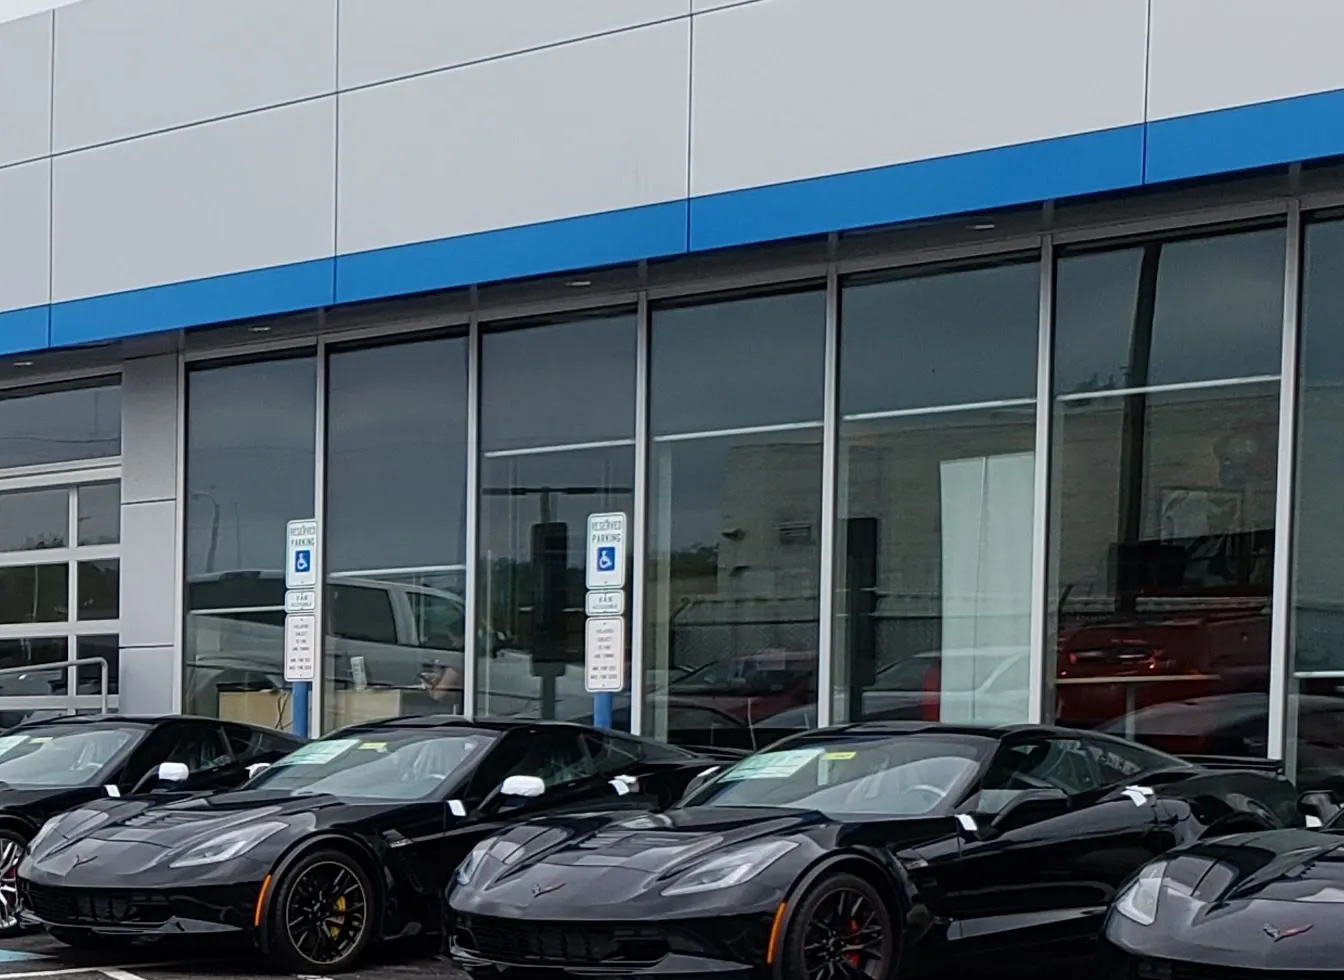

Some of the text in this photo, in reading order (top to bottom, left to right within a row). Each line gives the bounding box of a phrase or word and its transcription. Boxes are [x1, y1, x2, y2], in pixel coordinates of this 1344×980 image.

[591, 520, 622, 531] RESERVED
[290, 526, 316, 536] RESERVED
[290, 537, 315, 546] PARKING
[591, 533, 621, 543] PARKING
